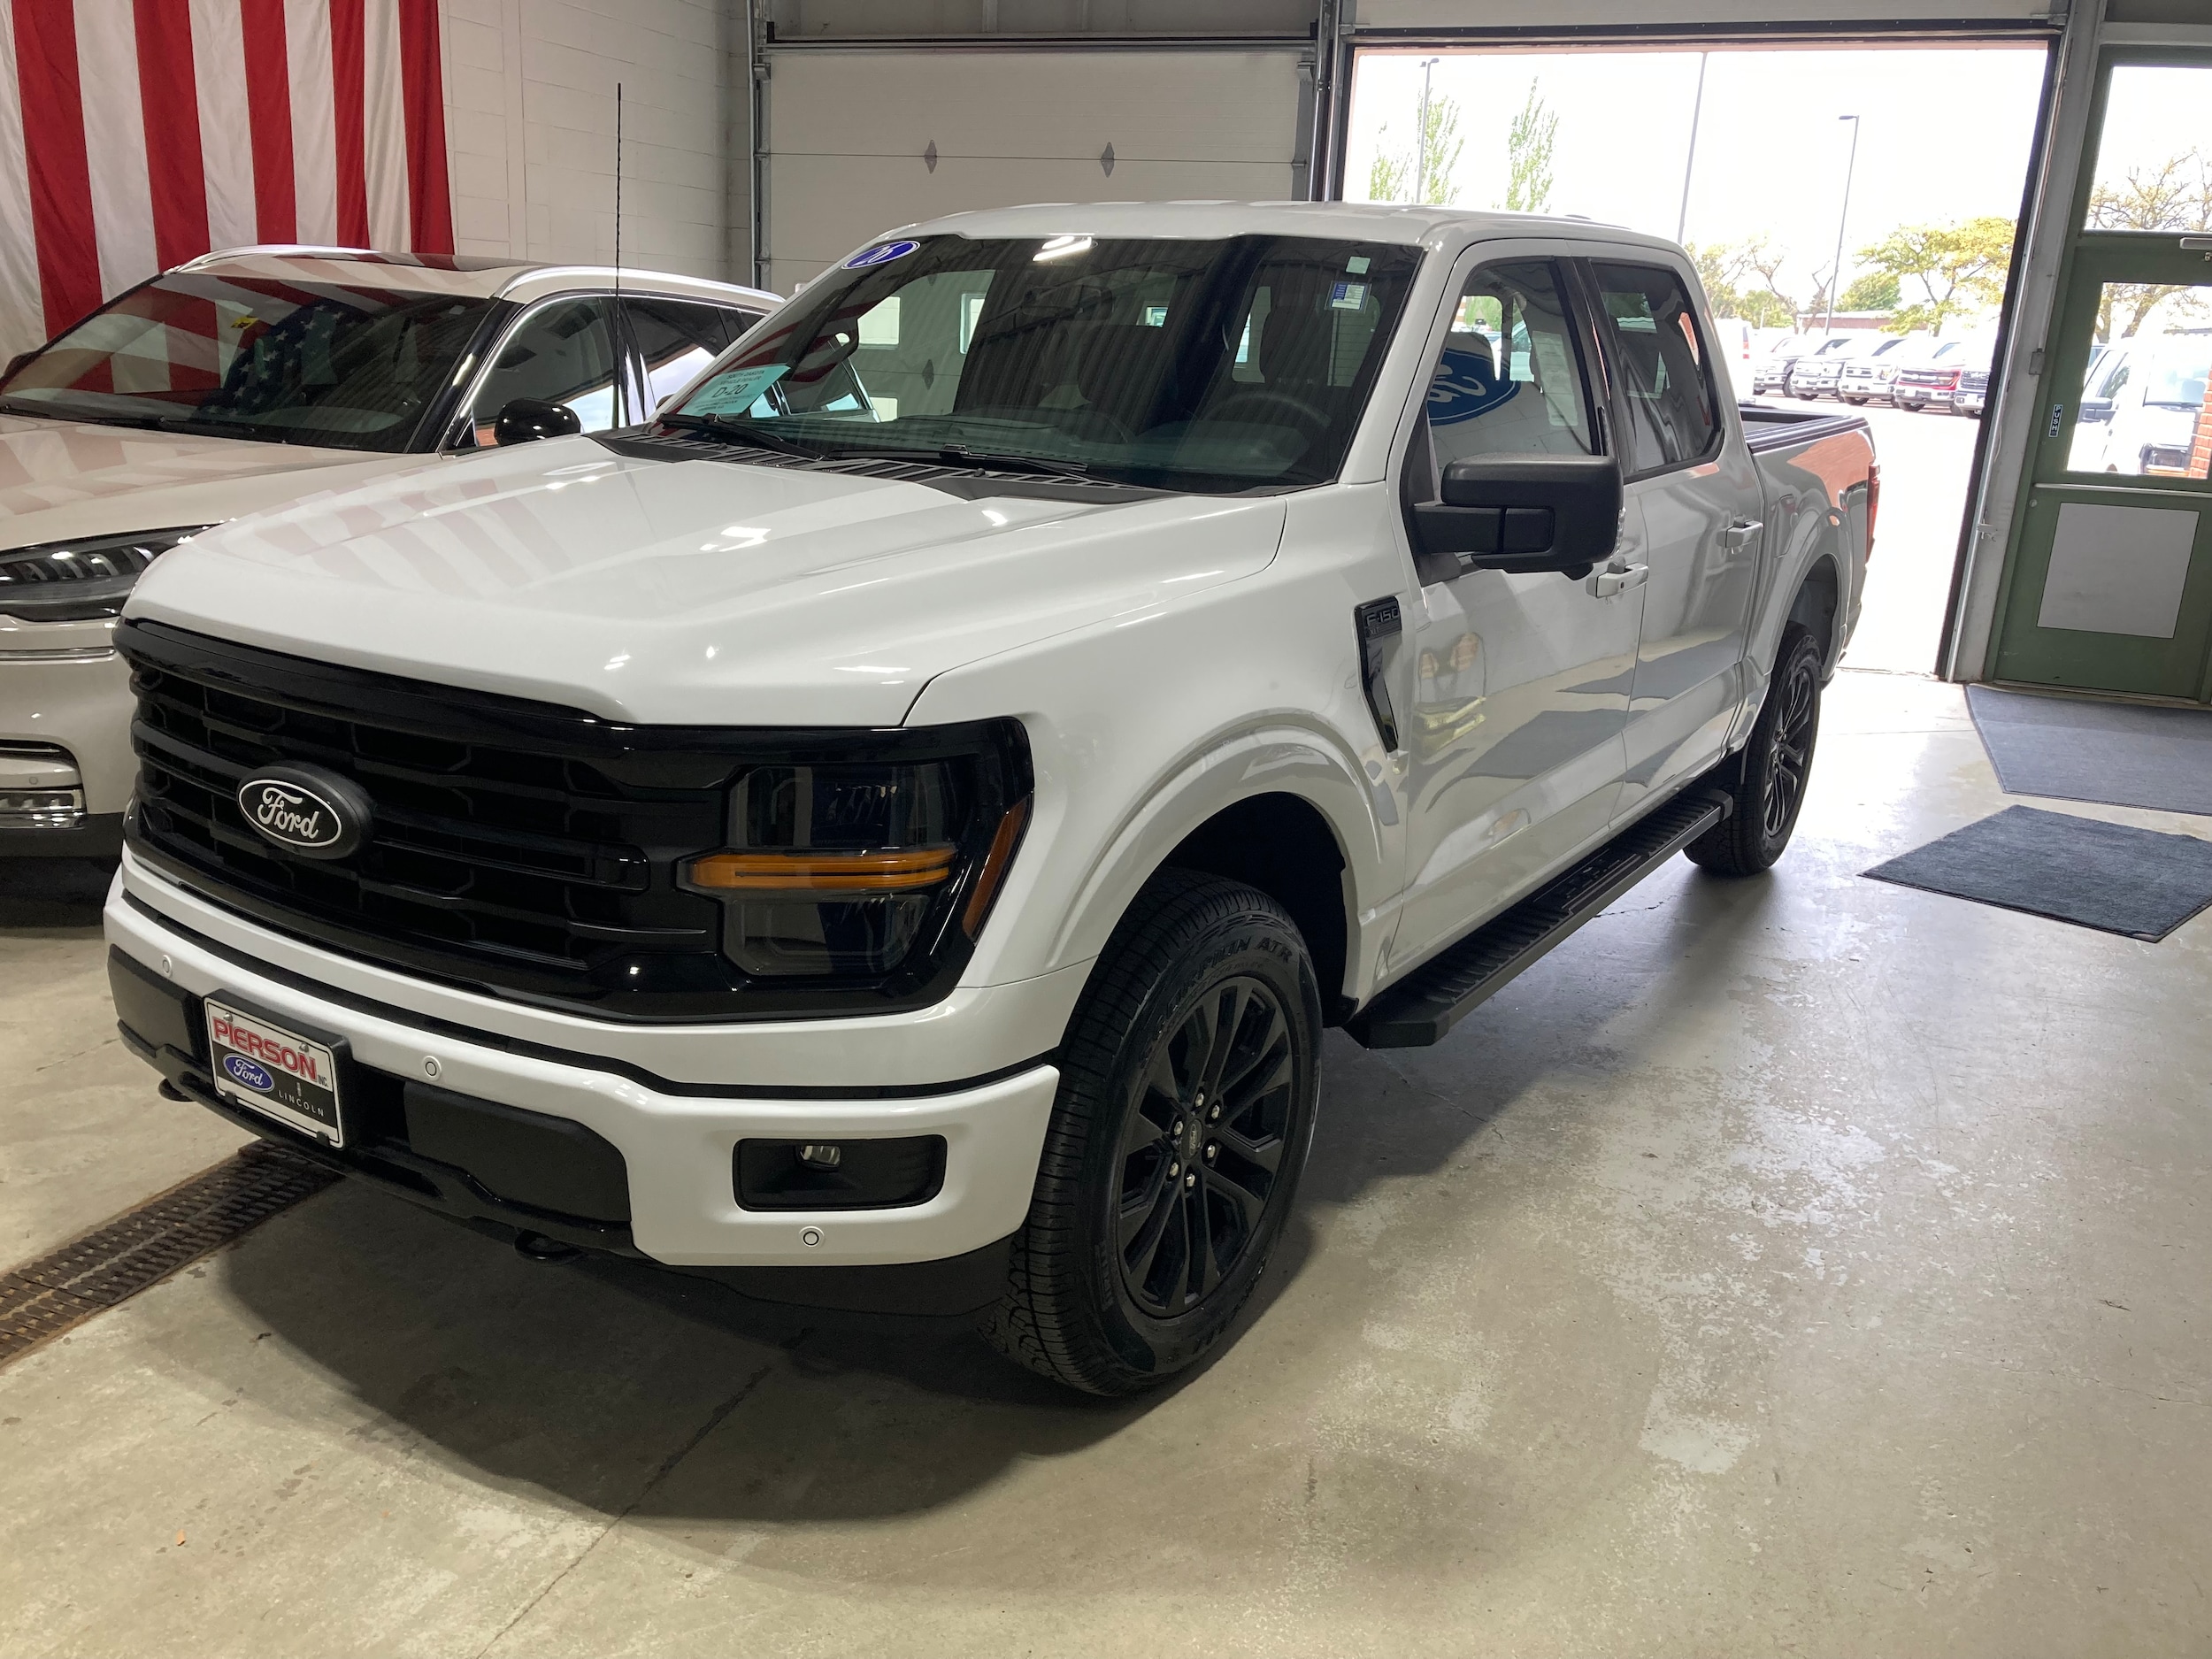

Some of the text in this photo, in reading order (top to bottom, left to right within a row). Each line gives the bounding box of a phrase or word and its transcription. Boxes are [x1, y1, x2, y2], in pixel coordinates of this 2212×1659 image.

[711, 383, 749, 398] D-20
[2051, 405, 2062, 431] PUSH
[1366, 607, 1400, 626] F-150
[257, 787, 319, 840] Ford
[212, 1017, 319, 1084] PIERSON
[233, 1058, 264, 1087] Ford
[278, 1089, 325, 1118] LINCOLN
